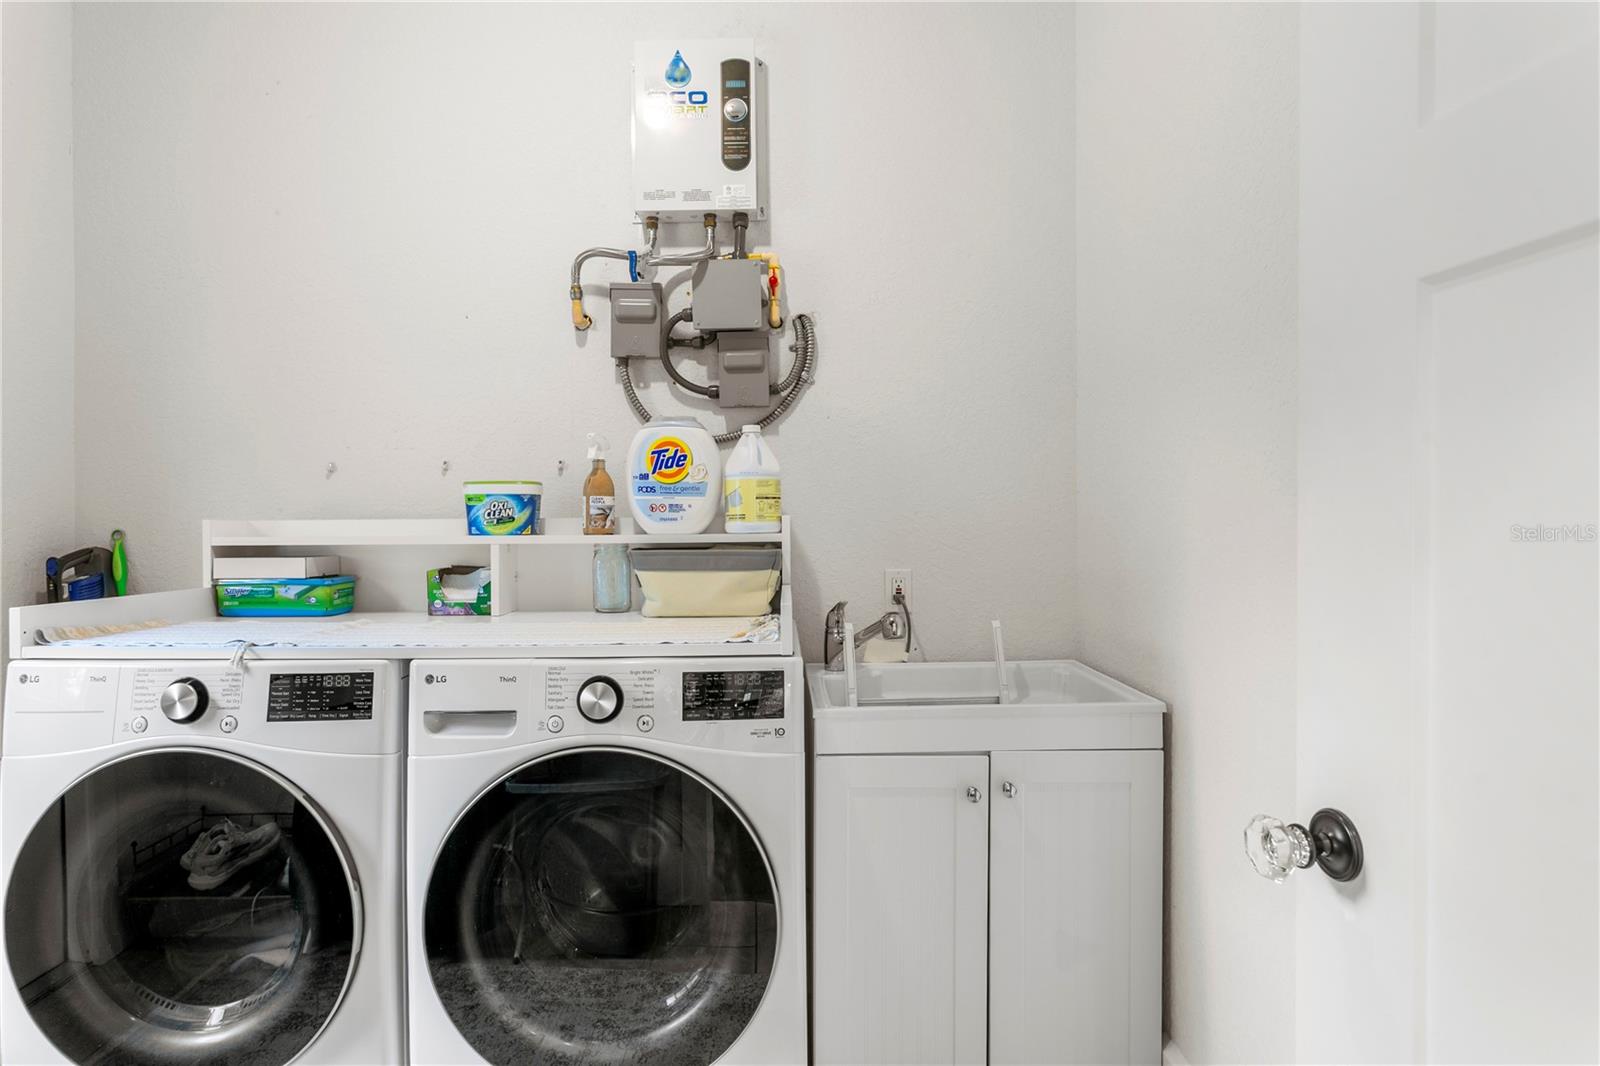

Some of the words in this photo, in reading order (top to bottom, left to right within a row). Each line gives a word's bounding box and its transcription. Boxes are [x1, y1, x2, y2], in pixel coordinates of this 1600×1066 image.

[650, 448, 688, 475] Tide
[490, 501, 508, 510] OXI
[484, 508, 513, 520] CLEAN
